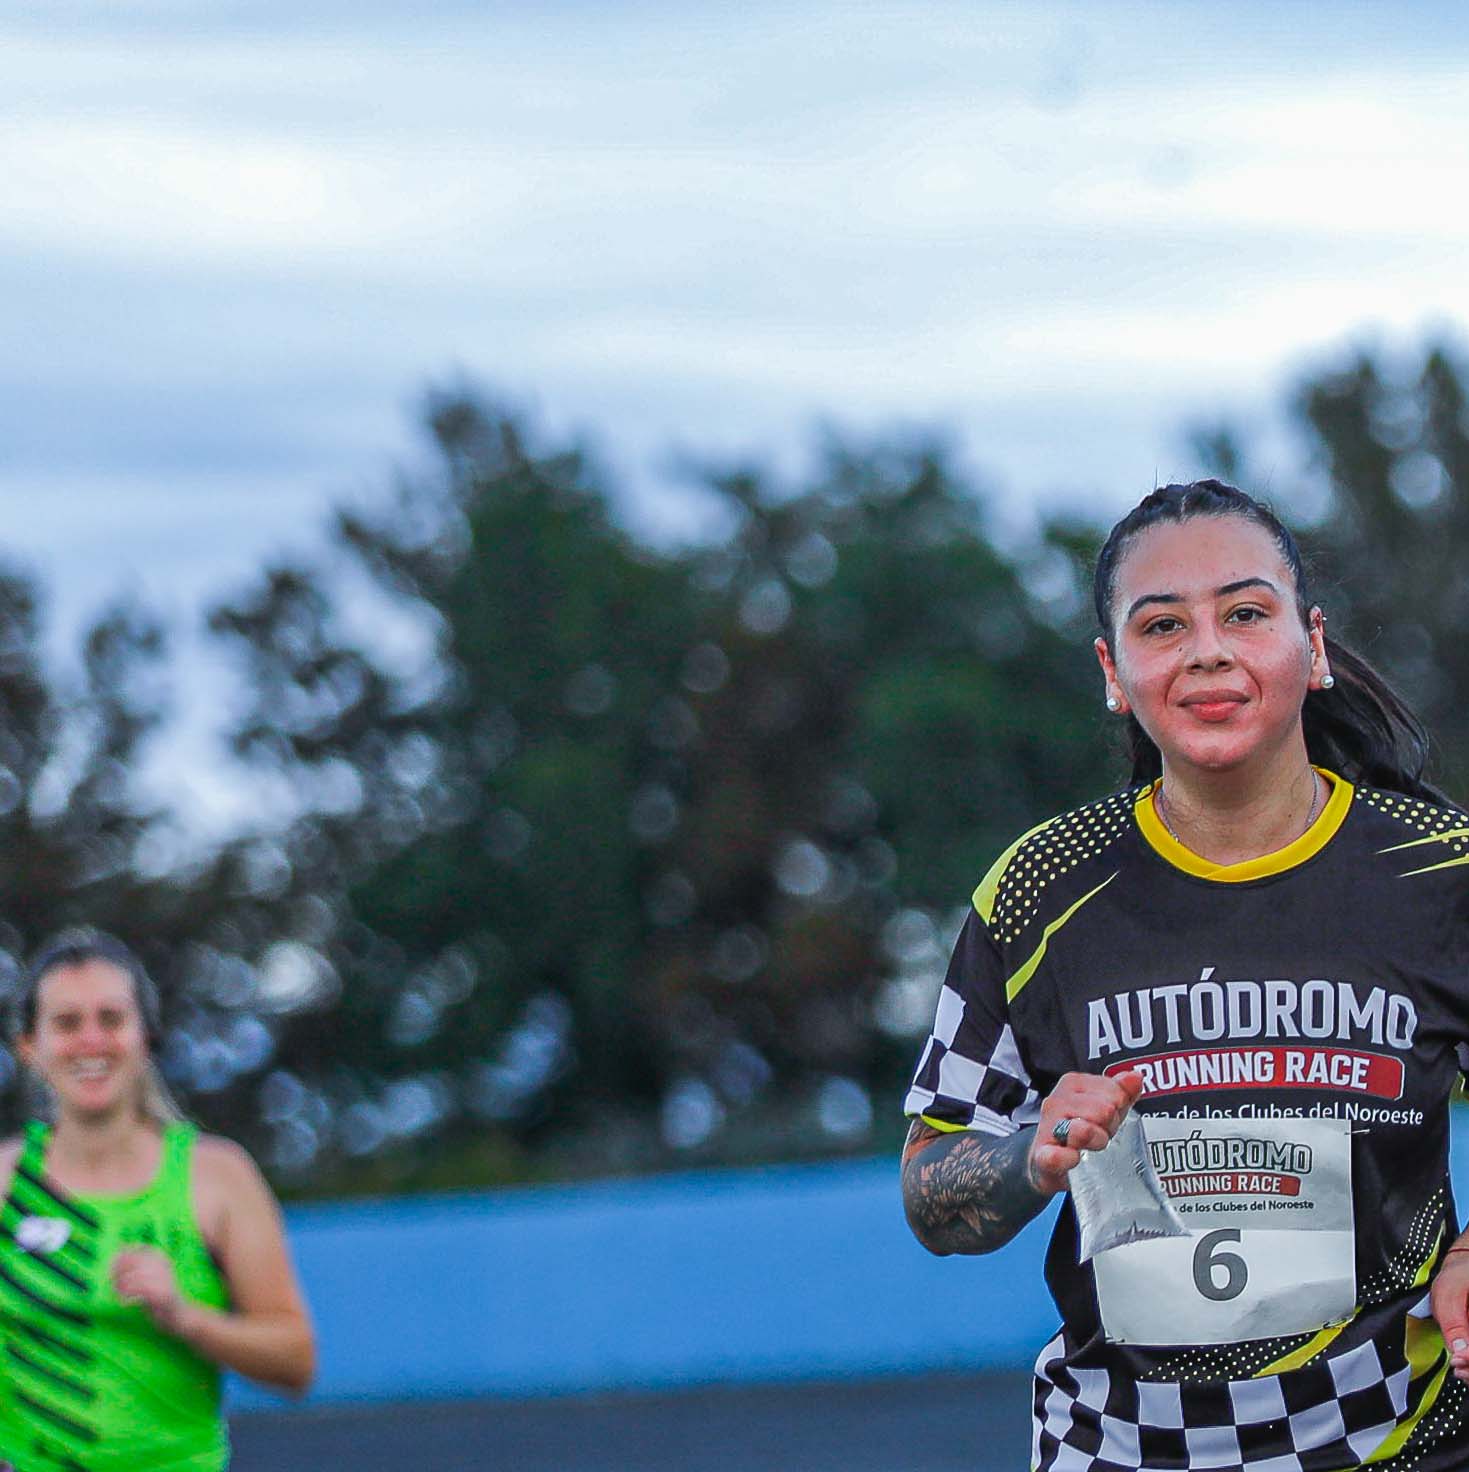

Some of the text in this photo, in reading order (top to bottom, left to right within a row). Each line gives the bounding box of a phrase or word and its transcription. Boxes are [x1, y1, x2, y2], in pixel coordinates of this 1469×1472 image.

[1087, 967, 1418, 1060] AUTÓDROMO
[1133, 1050, 1370, 1095] RUNNING RACE
[1176, 1104, 1200, 1119] de
[1206, 1104, 1232, 1119] los
[1238, 1103, 1303, 1119] Clubes
[1309, 1103, 1339, 1120] del
[1345, 1103, 1424, 1126] Noroeste
[1148, 1130, 1313, 1174] UTÓDROMO
[1237, 1174, 1282, 1193] RACE
[1179, 1200, 1315, 1213] de los Clubes del Noroeste
[1192, 1227, 1249, 1302] 6
